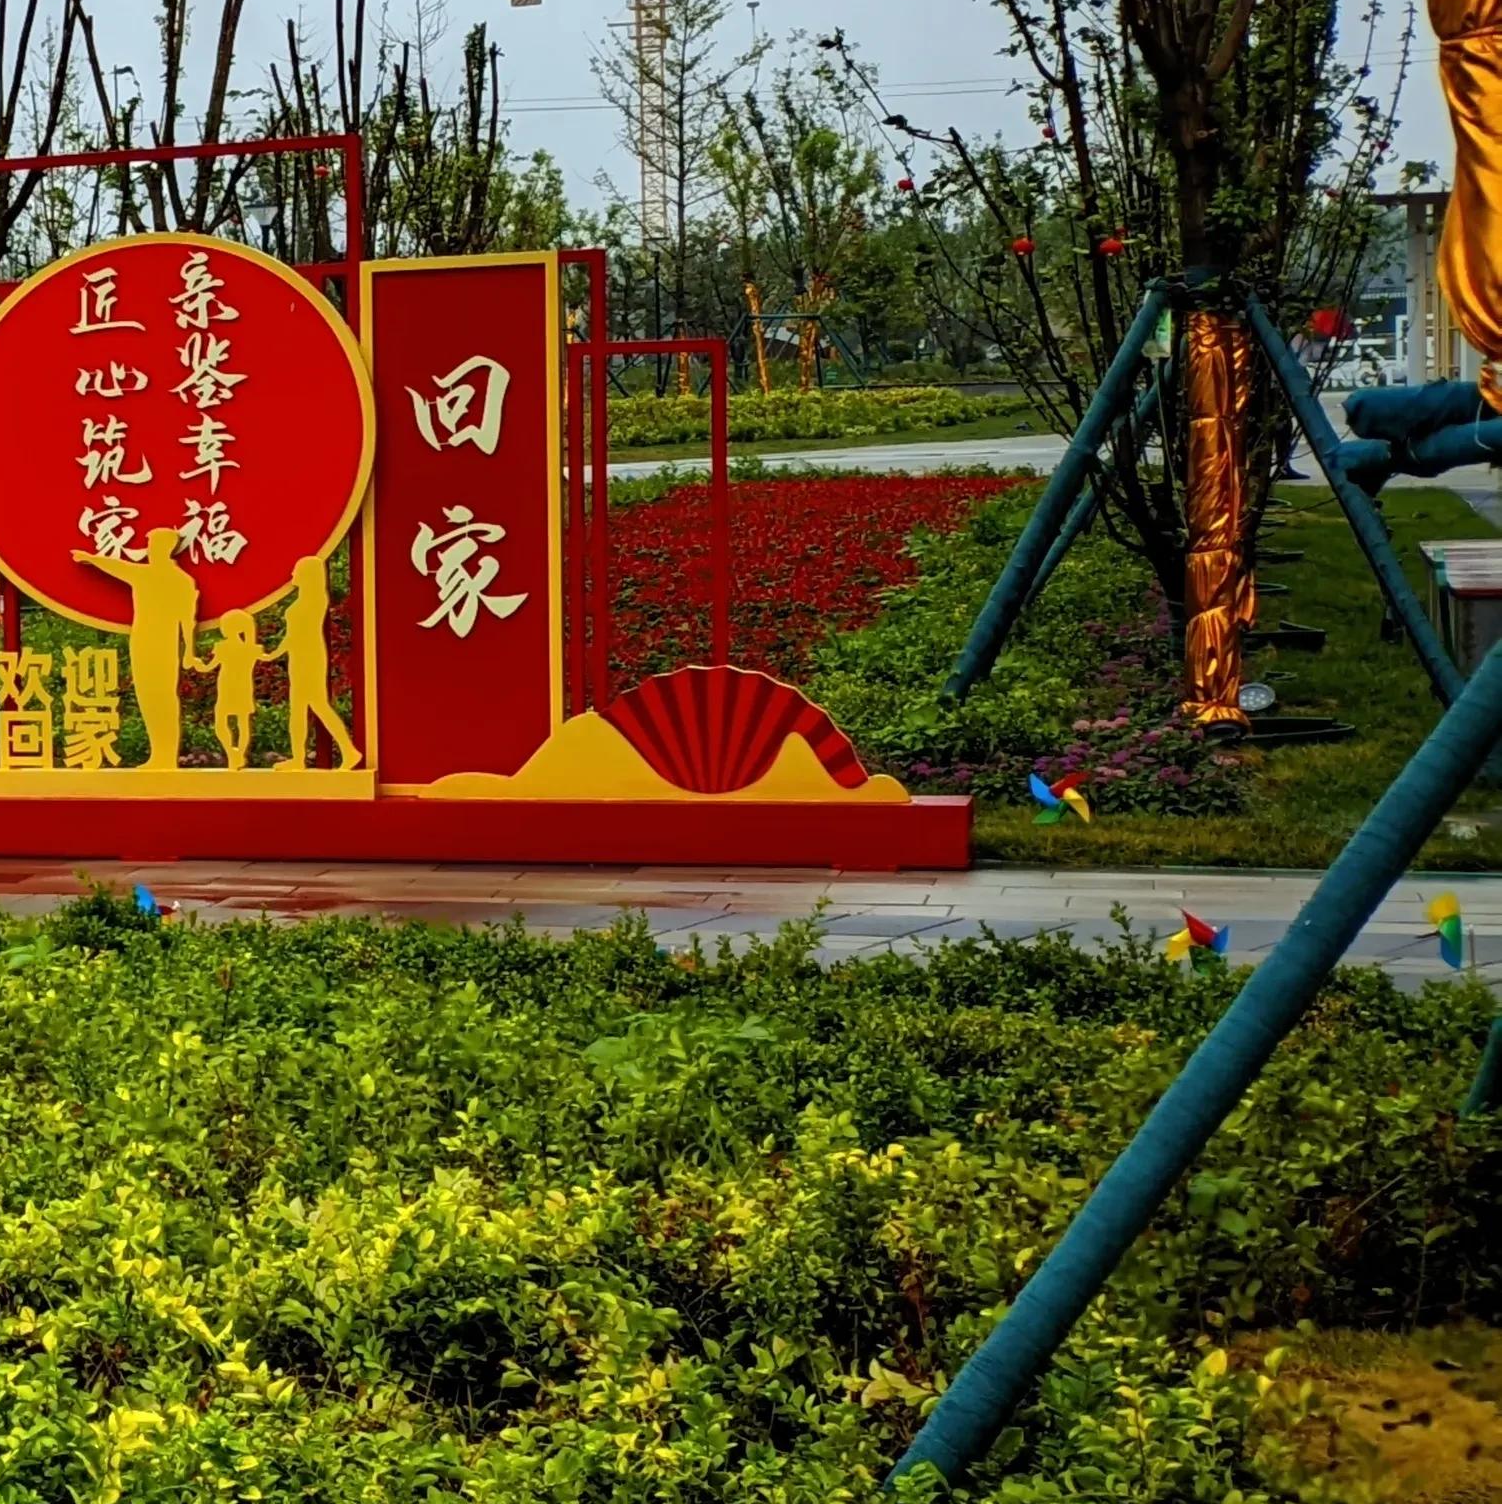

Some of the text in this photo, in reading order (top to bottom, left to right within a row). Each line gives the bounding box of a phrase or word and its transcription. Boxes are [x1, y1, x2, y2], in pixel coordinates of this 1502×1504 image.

[69, 267, 153, 562] 匠心筑家
[404, 354, 528, 638] 回家
